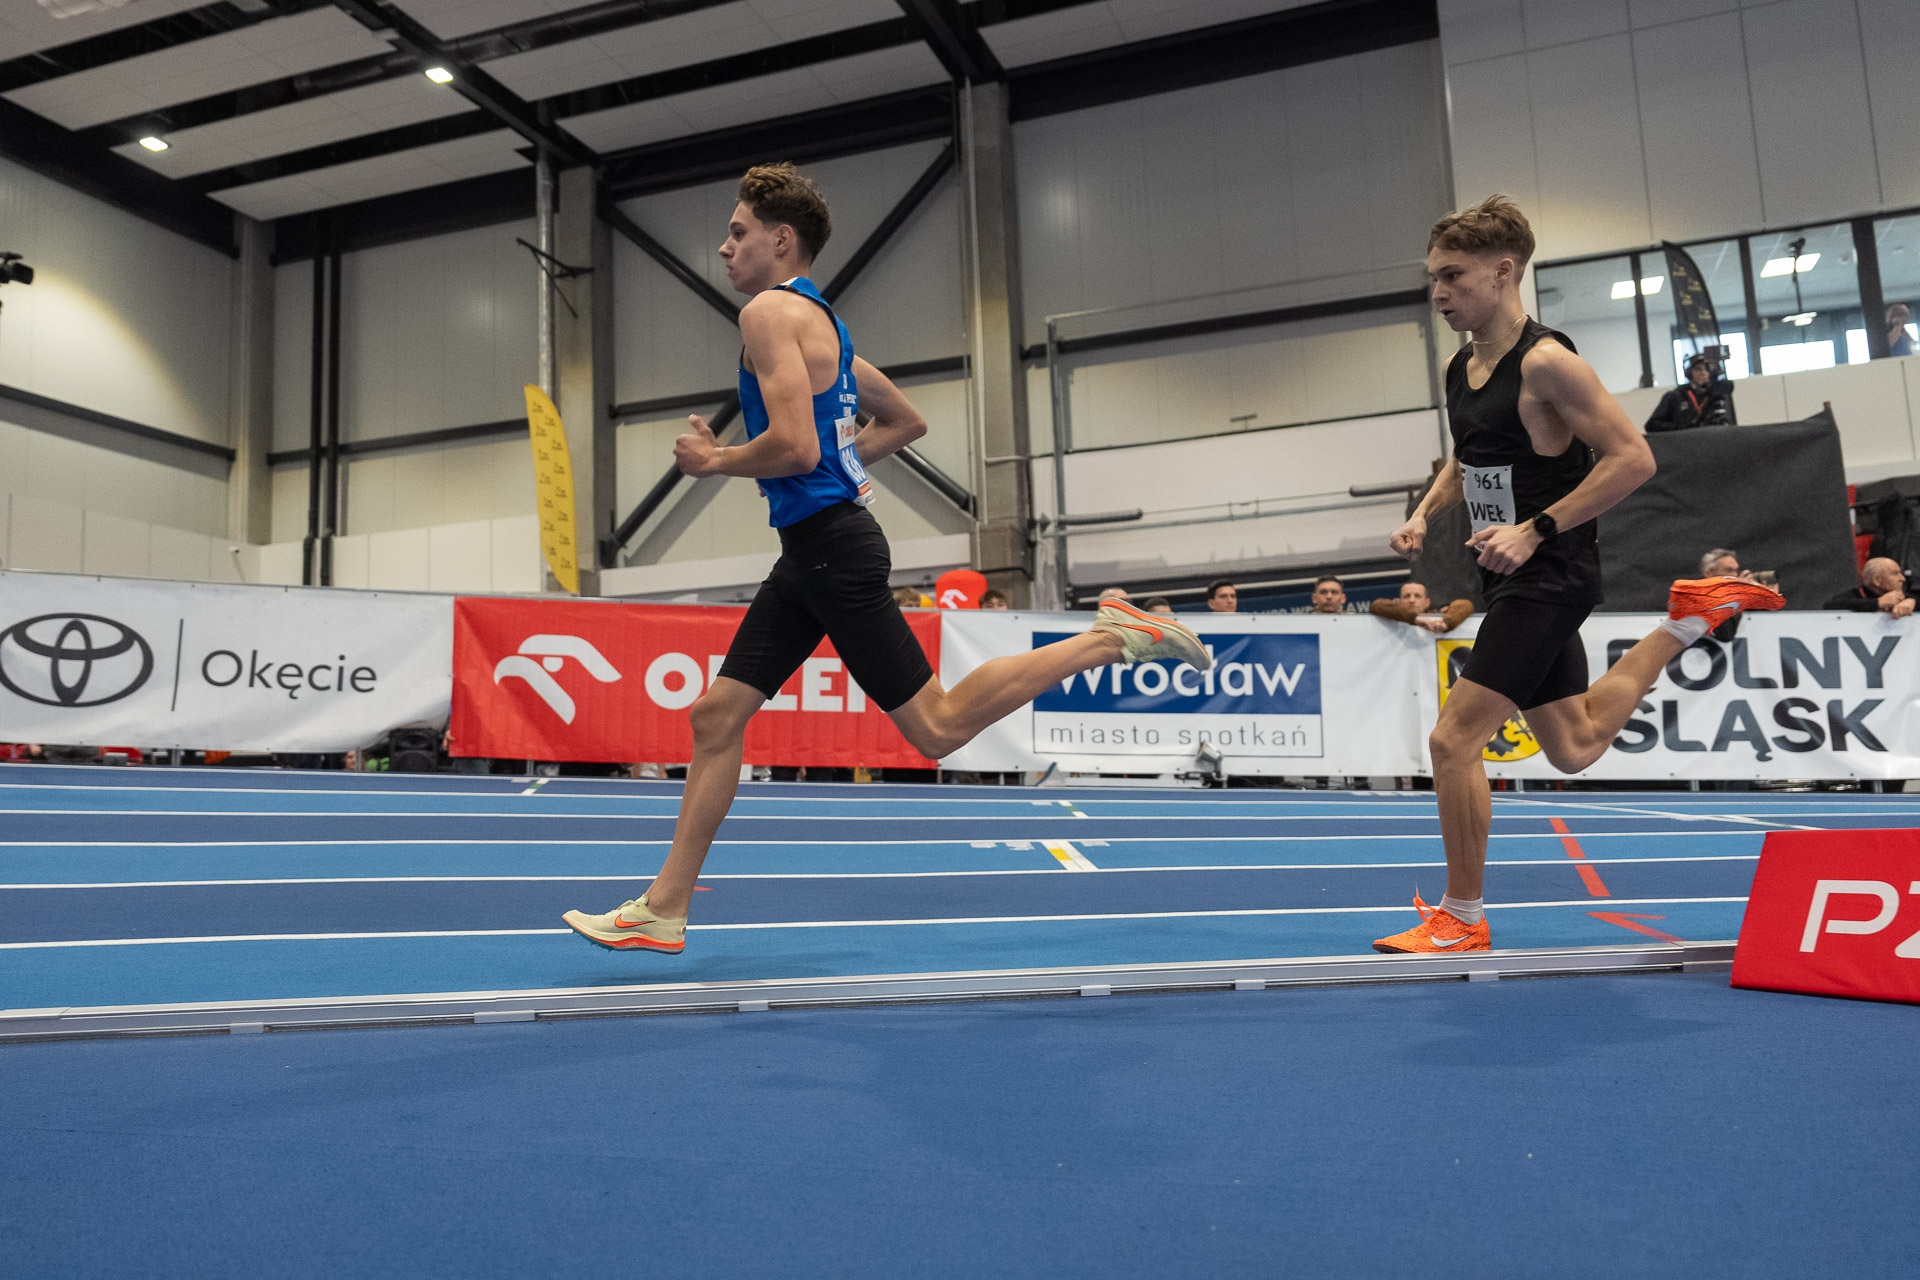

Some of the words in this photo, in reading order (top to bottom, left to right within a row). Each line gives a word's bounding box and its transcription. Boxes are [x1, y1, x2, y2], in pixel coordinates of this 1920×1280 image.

[1474, 472, 1504, 490] 961
[201, 649, 378, 700] Okęcie
[1050, 722, 1160, 745] miasto
